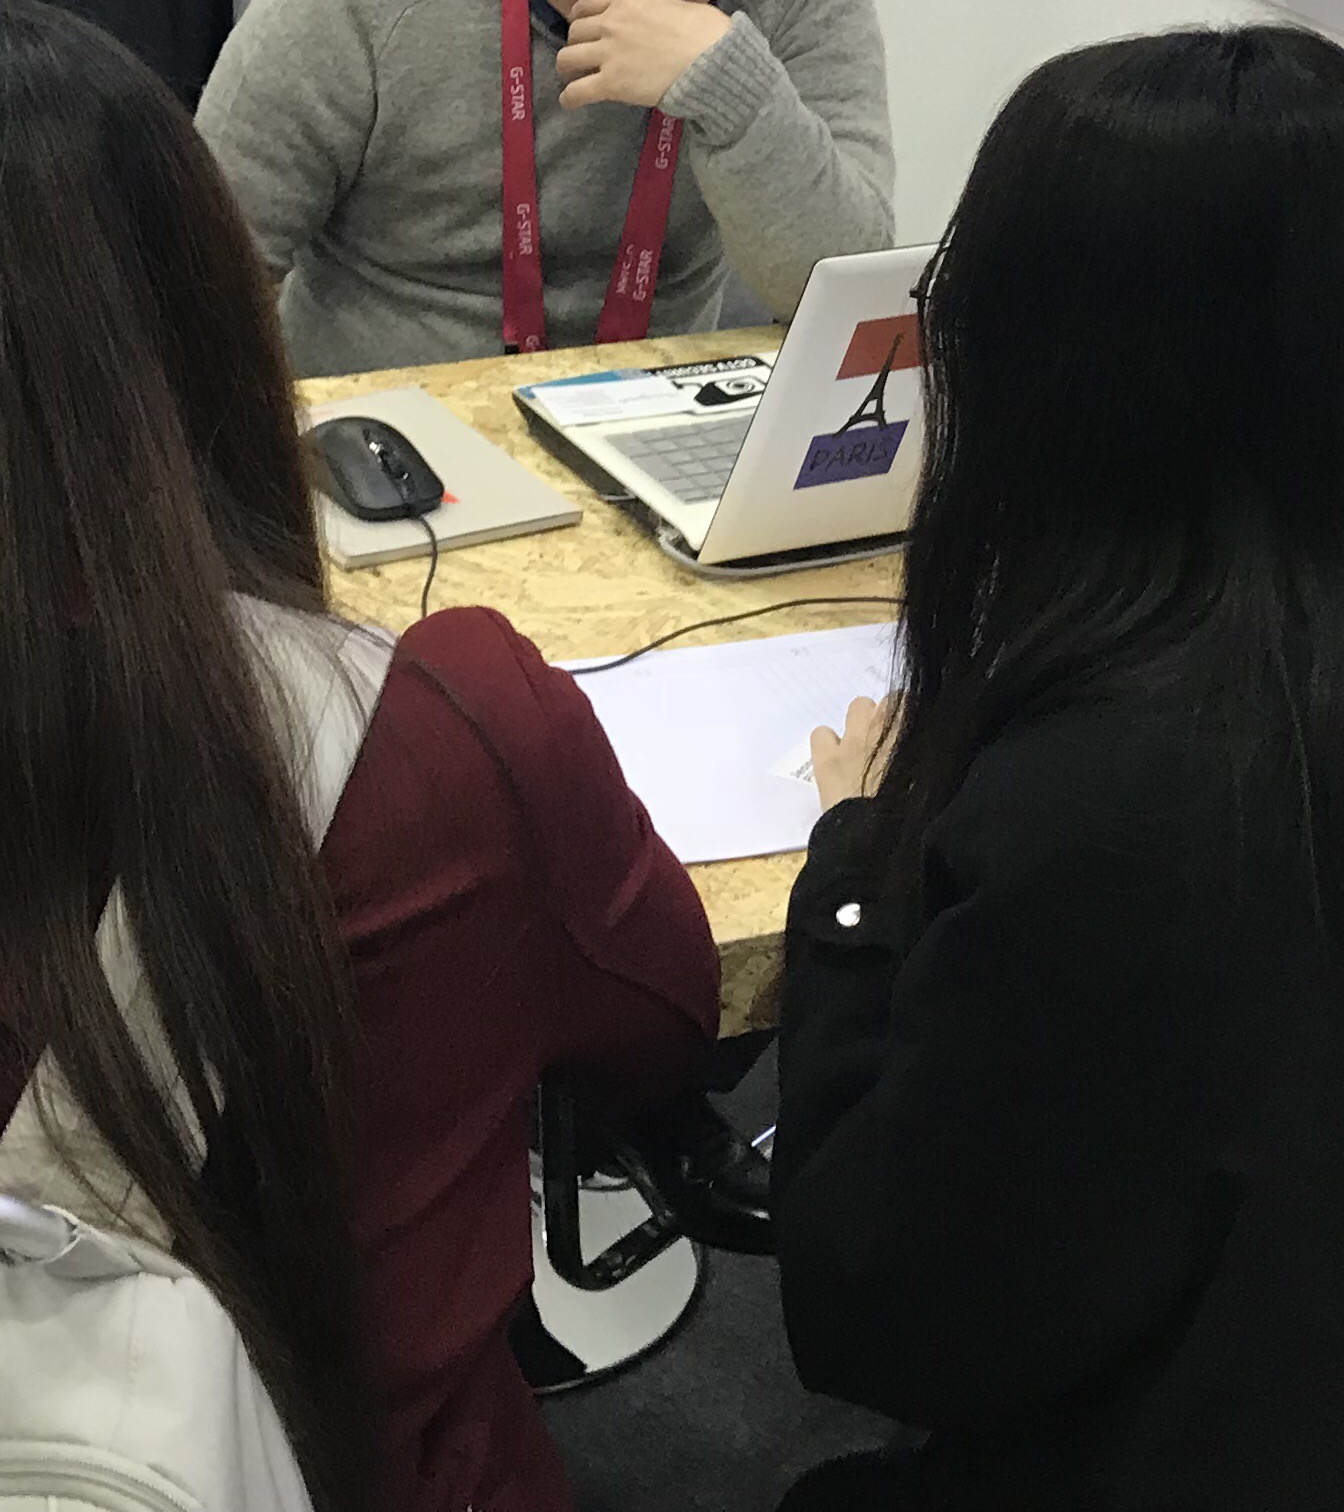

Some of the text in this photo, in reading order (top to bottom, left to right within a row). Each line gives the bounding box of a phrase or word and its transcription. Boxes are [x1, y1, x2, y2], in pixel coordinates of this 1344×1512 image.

[510, 66, 526, 121] G-STAR
[516, 203, 533, 255] G-STAR
[632, 248, 654, 302] G-STAR
[809, 435, 894, 472] PARIS
